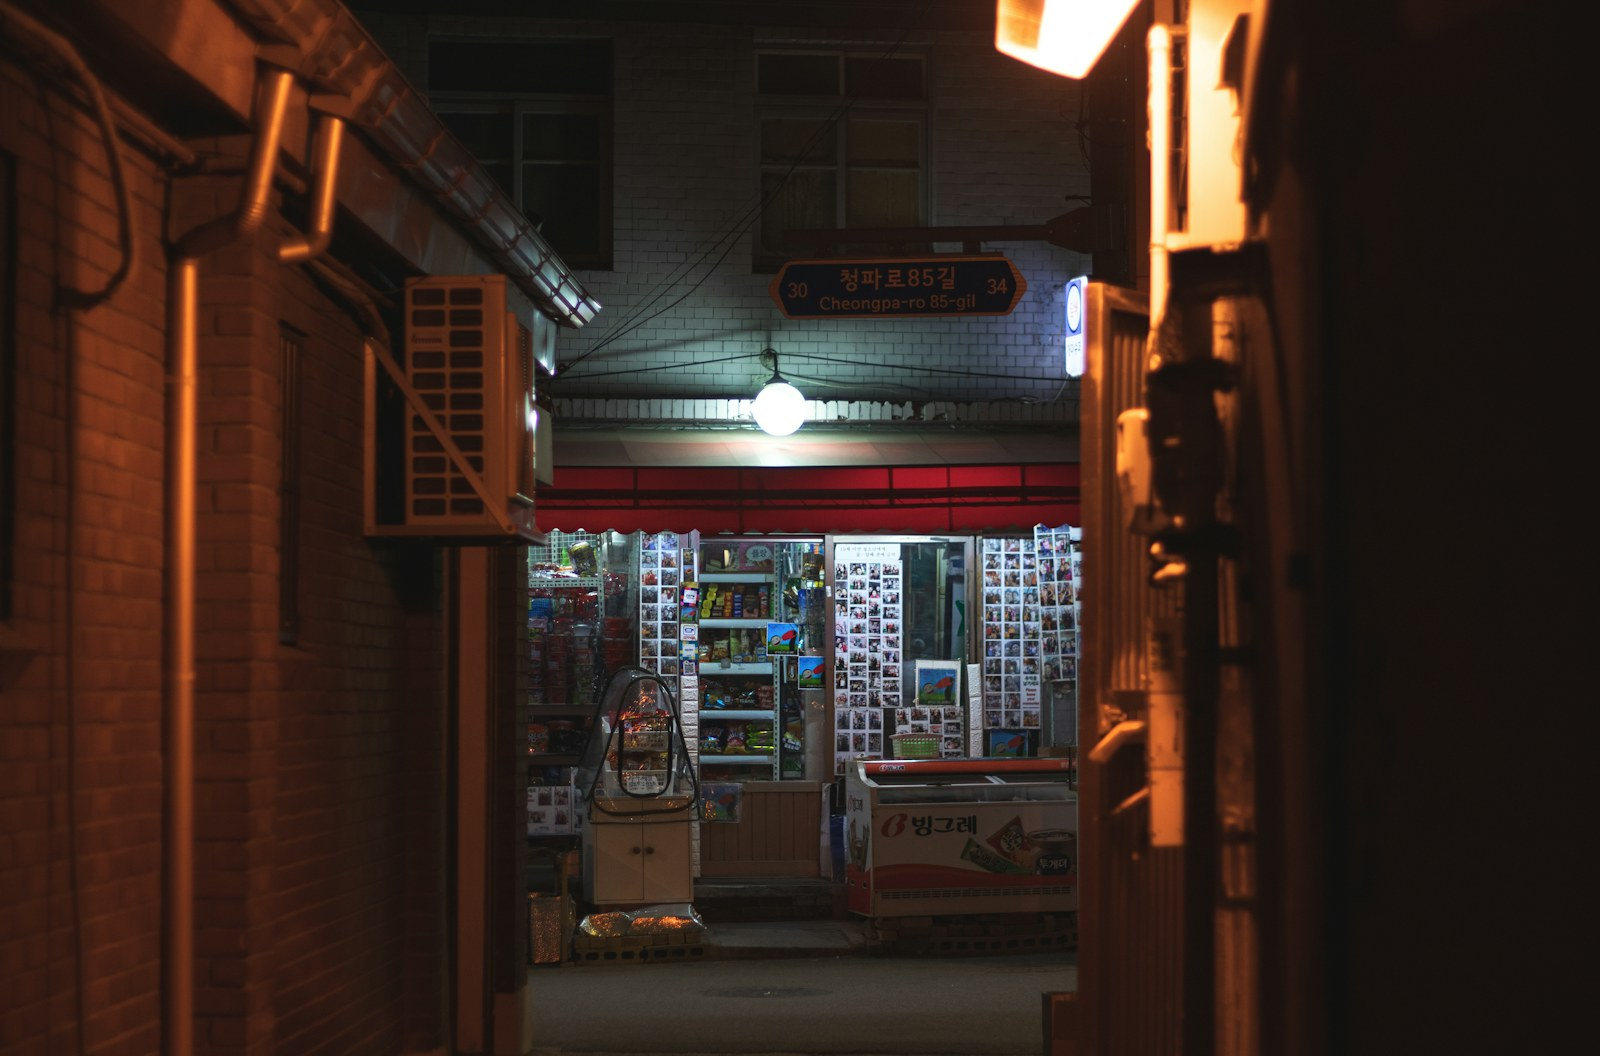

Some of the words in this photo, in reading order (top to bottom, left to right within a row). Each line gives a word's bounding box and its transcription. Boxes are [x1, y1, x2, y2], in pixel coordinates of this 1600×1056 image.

[840, 266, 956, 292] 청파로85길
[986, 278, 1008, 295] 34
[787, 282, 808, 299] 30
[819, 295, 924, 313] Cheongpa-ro
[929, 294, 976, 311] 85-gil
[911, 814, 977, 837] 빙그레
